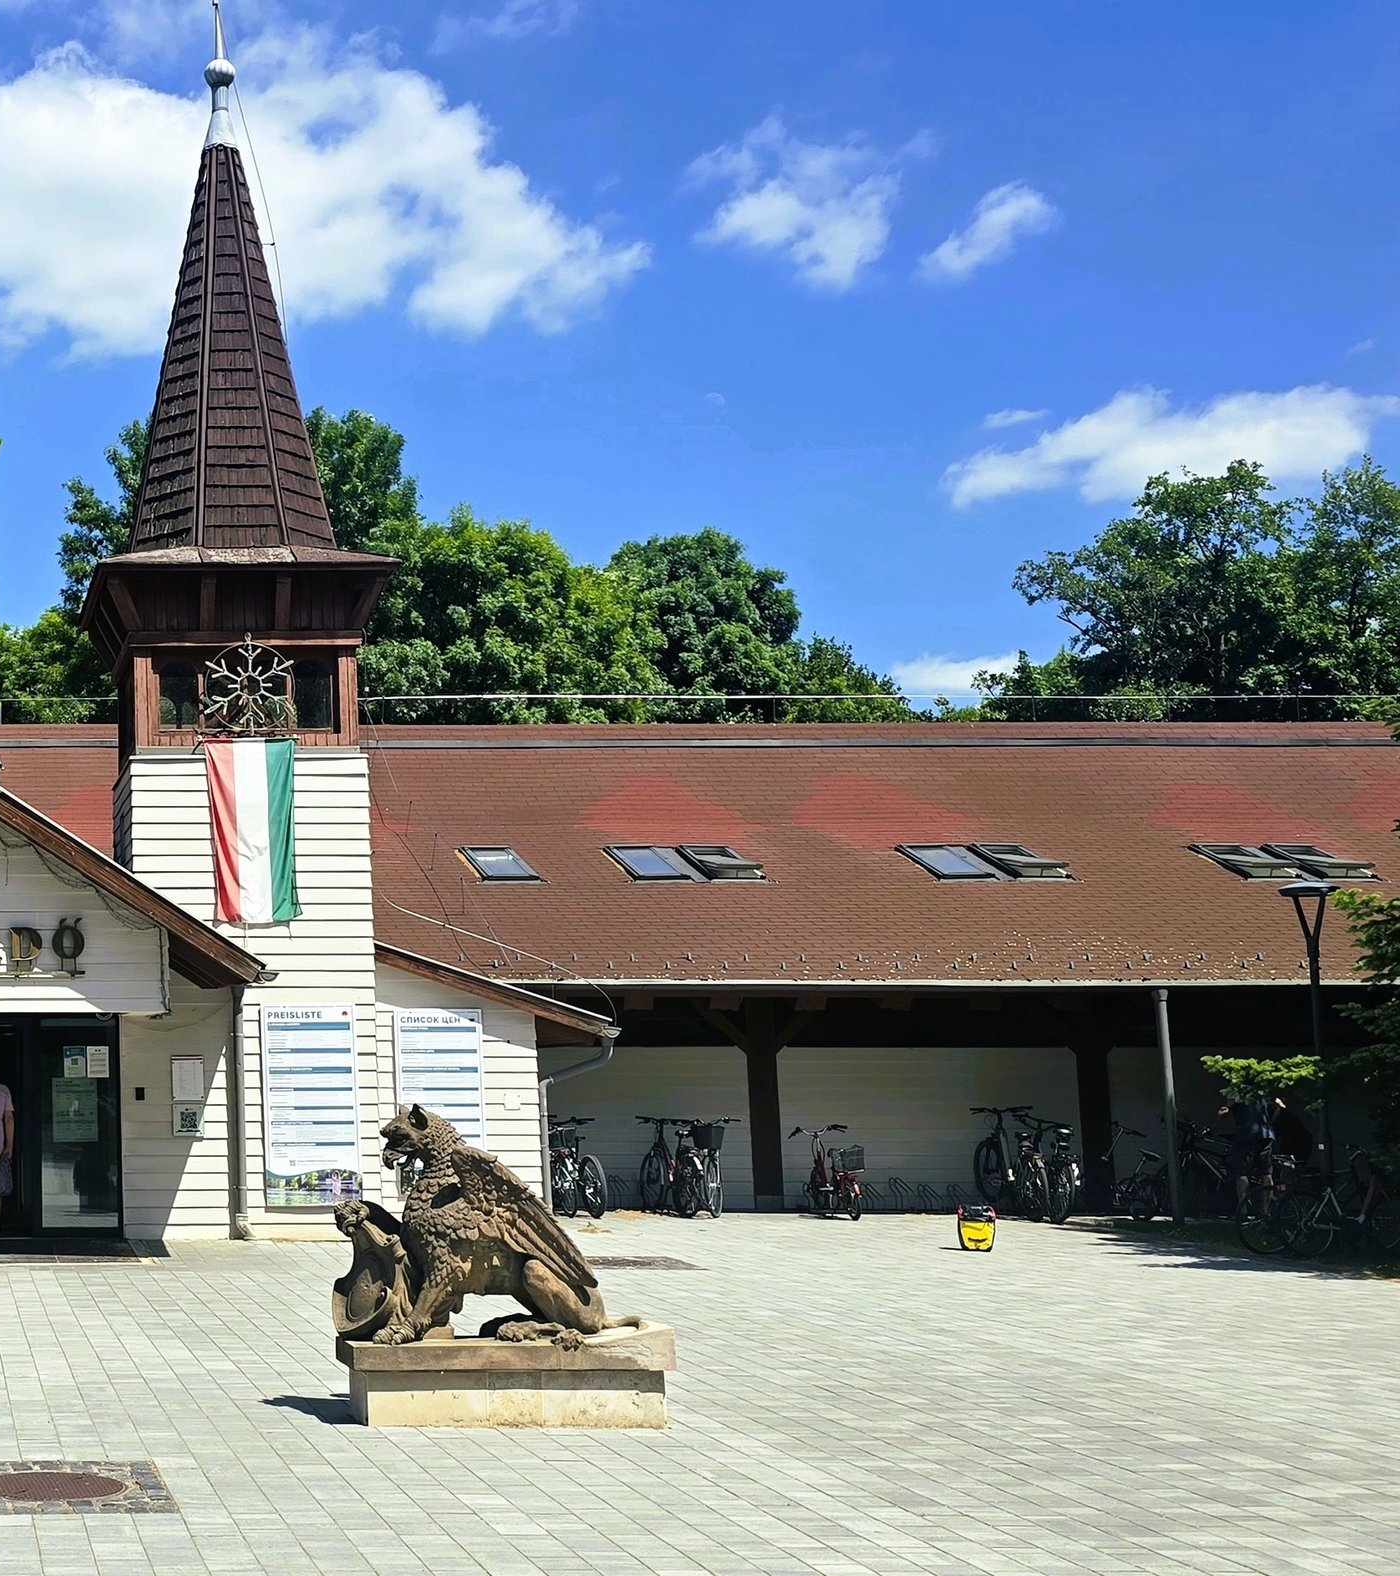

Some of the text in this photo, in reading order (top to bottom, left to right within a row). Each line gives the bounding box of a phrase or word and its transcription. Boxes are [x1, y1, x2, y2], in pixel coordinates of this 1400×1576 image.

[267, 1011, 323, 1020] PREISLISTE
[400, 1016, 461, 1025] СПИСОК ЦЕН
